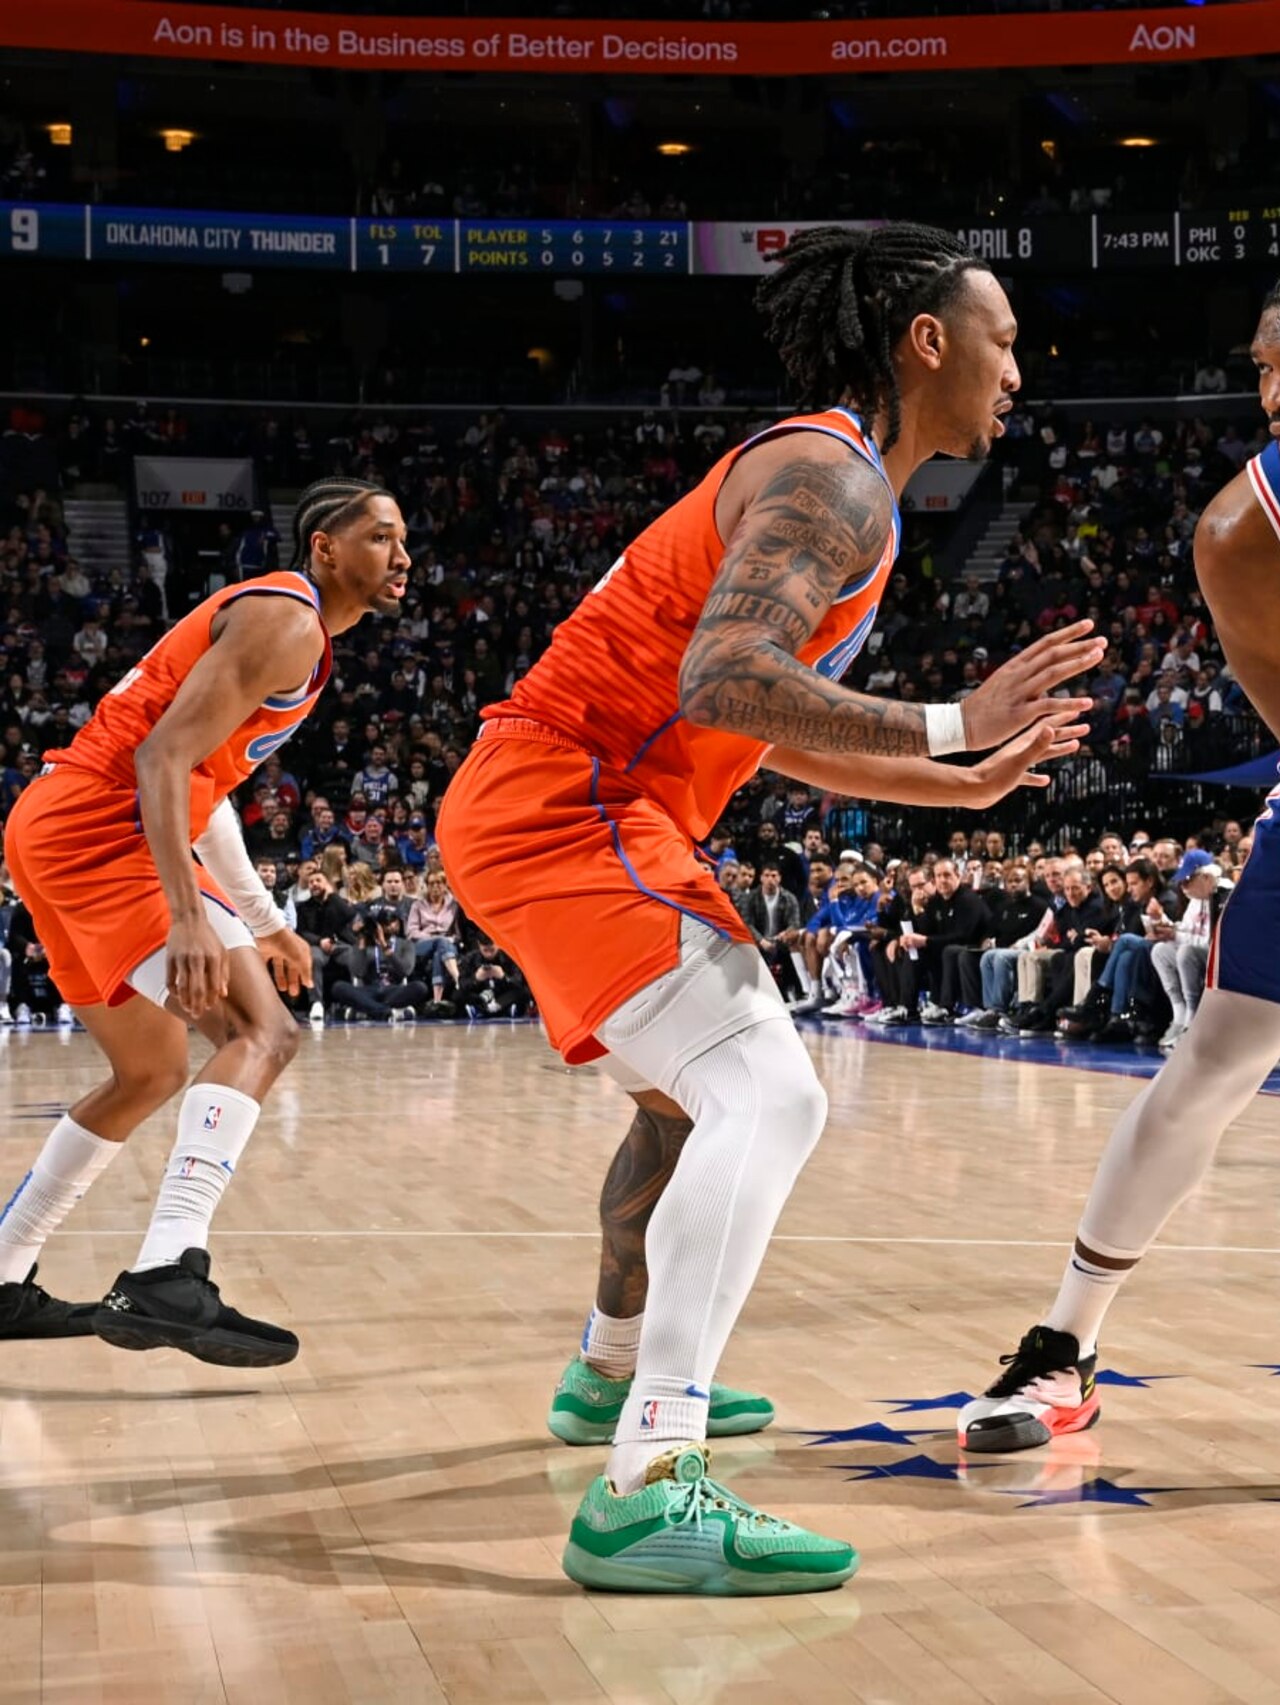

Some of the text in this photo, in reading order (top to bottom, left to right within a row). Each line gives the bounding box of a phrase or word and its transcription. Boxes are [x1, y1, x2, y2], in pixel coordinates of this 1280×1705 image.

[153, 17, 738, 61] Aon is in the Business of Better Decisions
[831, 36, 948, 60] aon.com
[1129, 24, 1196, 51] AON
[10, 208, 39, 251] 9
[106, 223, 336, 254] OKLAHOMA CITY THUNDER
[369, 224, 442, 240] FLS TOL
[467, 229, 679, 245] PLAYER 5 6 7 3 21
[1103, 231, 1170, 249] 7:43 PM
[1189, 227, 1217, 244] PHI
[1233, 224, 1246, 240] 0
[1269, 222, 1278, 238] 1
[378, 244, 436, 266] 1 7
[957, 228, 1033, 260] APRIL 8
[1186, 245, 1220, 262] OKC
[1233, 243, 1246, 260] 3
[1268, 241, 1279, 257] 4
[468, 251, 674, 267] POINTS 0 0 5 2 2
[141, 491, 171, 506] 107
[773, 521, 850, 568] ARKANSAS
